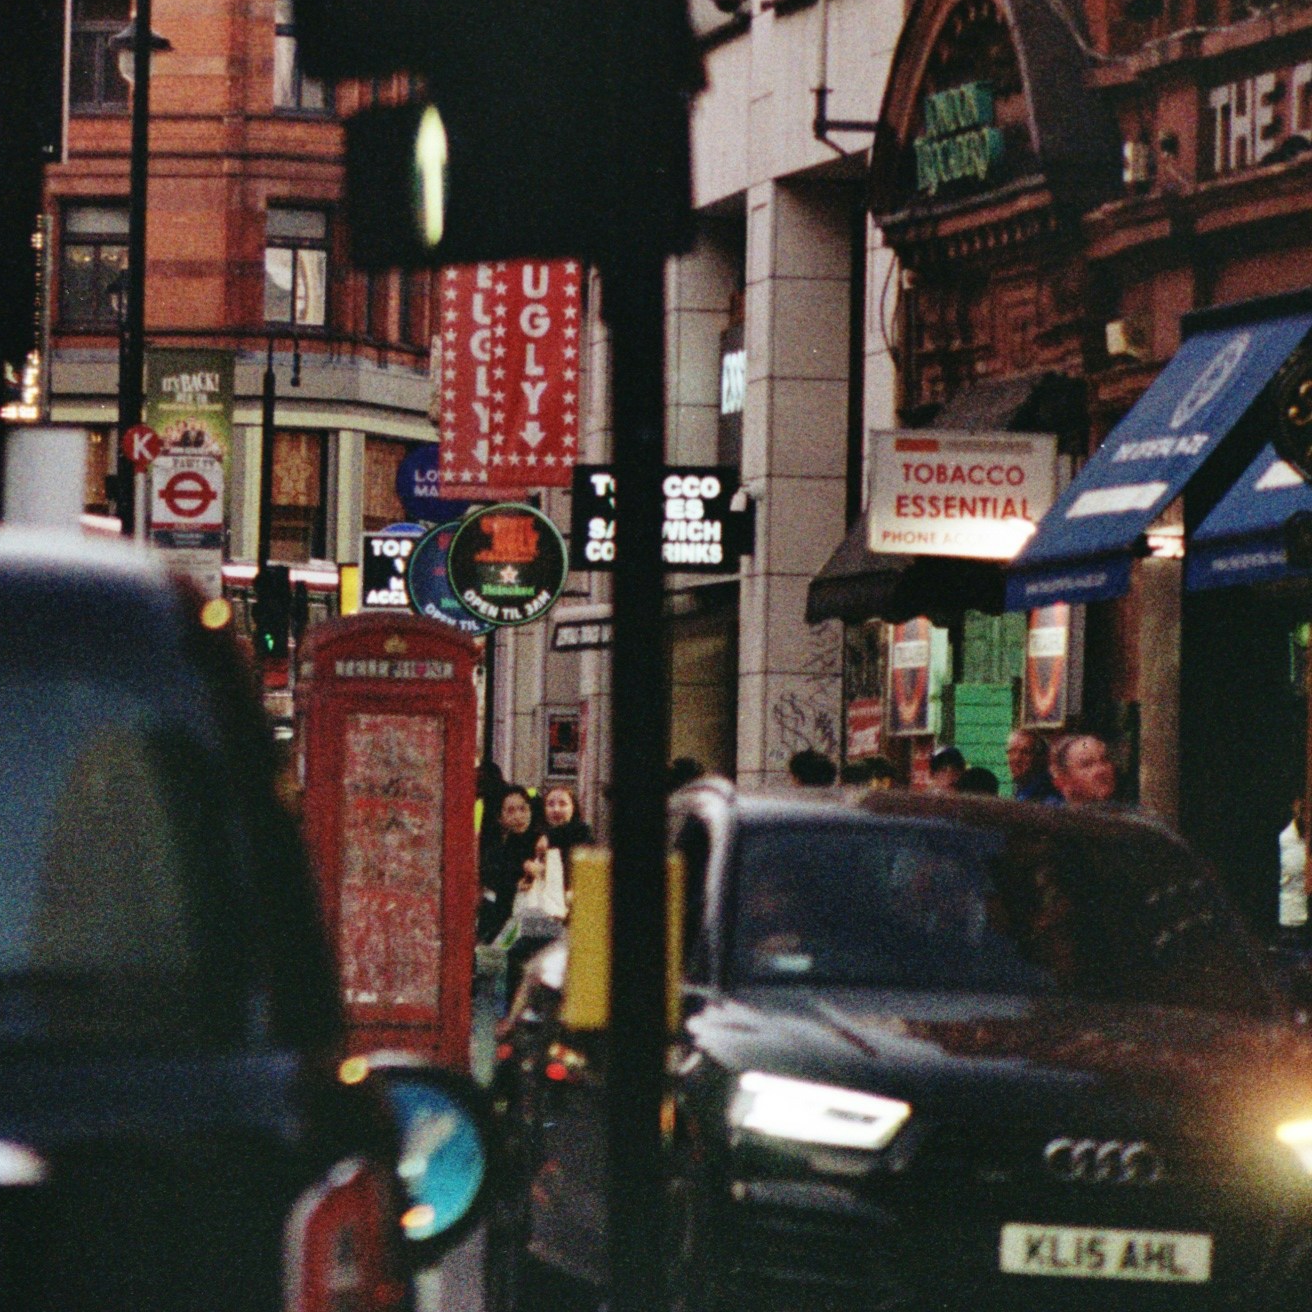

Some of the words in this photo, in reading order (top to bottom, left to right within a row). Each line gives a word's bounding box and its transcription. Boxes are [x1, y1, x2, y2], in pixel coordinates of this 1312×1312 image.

[1209, 72, 1276, 172] THE
[519, 265, 551, 415] UGLY
[133, 433, 153, 460] K
[902, 463, 1025, 486] TOBACCO
[895, 494, 1034, 520] ESSENTIAL
[463, 589, 499, 619] OPEN
[502, 608, 523, 620] TIL
[524, 590, 552, 617] 3AM
